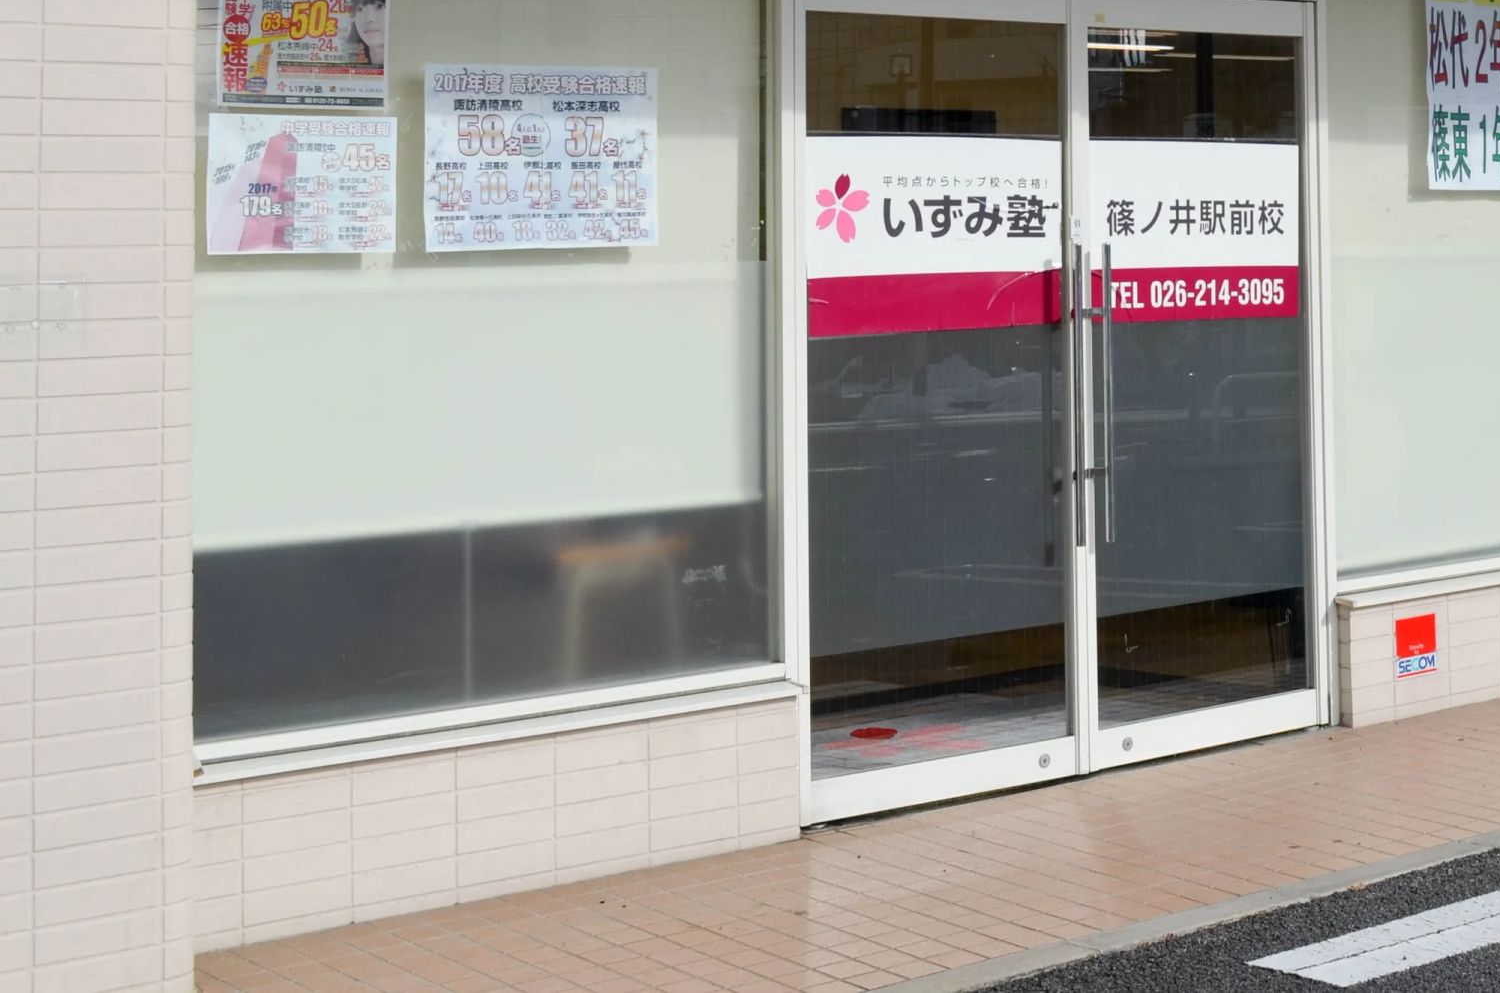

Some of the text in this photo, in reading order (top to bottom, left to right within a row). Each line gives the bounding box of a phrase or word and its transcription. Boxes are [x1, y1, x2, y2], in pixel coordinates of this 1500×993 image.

[224, 23, 250, 36] 合格
[223, 42, 248, 92] 速報
[434, 73, 503, 94] 2017年度
[882, 194, 1285, 239] いずみ塾 篠ノ井駅前校
[1111, 278, 1285, 309] TEL 026-214-3095
[1398, 655, 1435, 674] SECOM
